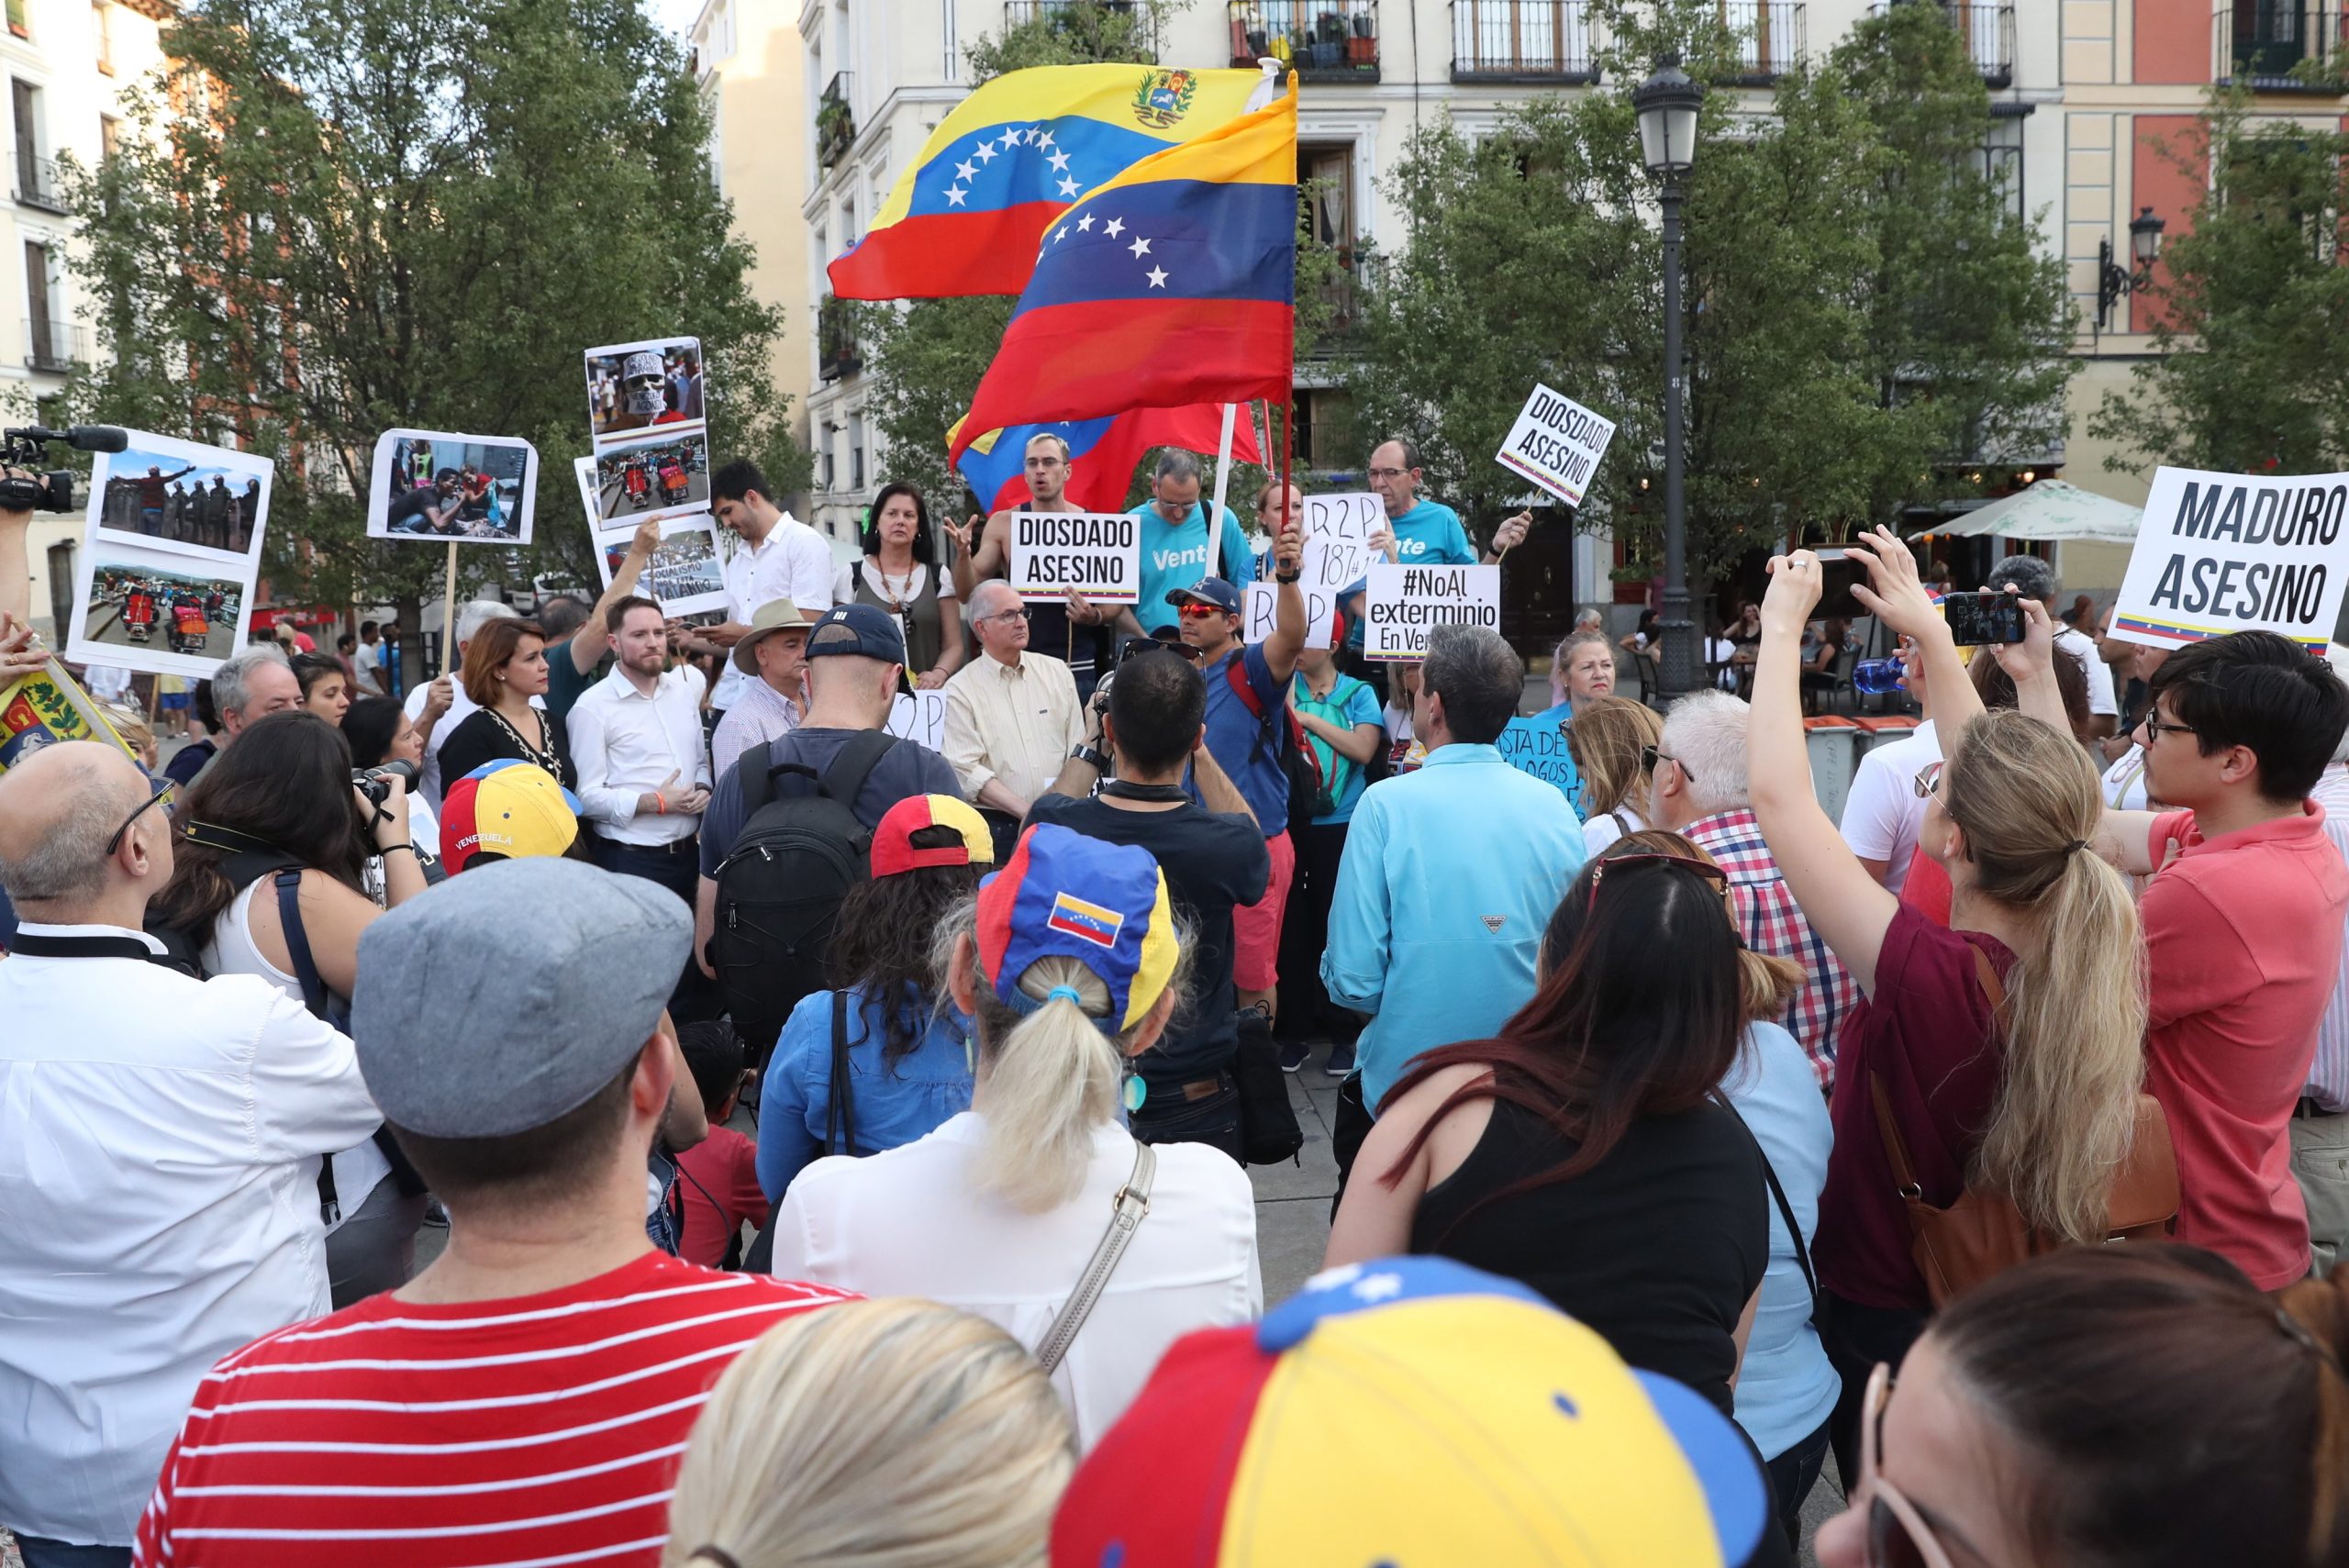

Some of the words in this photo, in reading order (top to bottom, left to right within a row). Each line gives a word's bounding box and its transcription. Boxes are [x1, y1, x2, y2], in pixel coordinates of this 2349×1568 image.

[1529, 392, 1610, 454] DIOSDADO
[1517, 428, 1590, 485] ASESINO
[2172, 482, 2348, 547] MADURO
[1019, 517, 1132, 548] DIOSDADO
[1027, 554, 1123, 584] ASESINO
[1152, 544, 1208, 571] Vent
[1403, 569, 1467, 597] #NoAl
[2149, 553, 2328, 625] ASESINO
[1370, 599, 1496, 627] exterminio
[1380, 627, 1400, 651] En
[1404, 628, 1431, 651] Ve
[1537, 730, 1565, 757] DE
[455, 832, 513, 851] VENEZUELA
